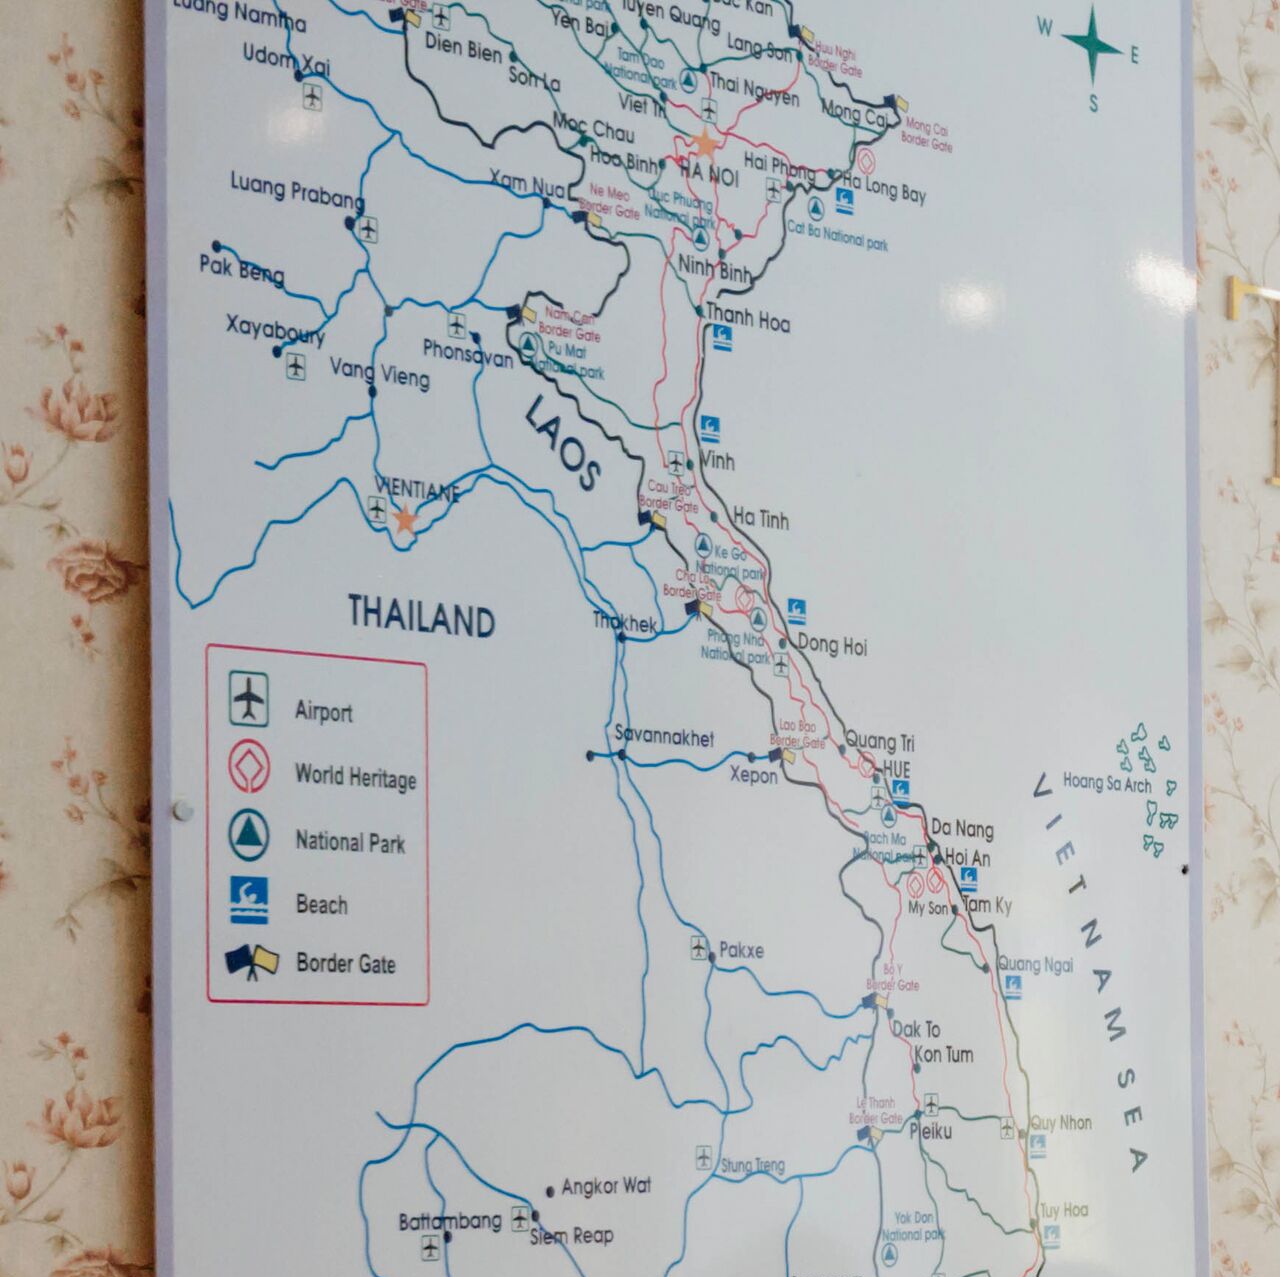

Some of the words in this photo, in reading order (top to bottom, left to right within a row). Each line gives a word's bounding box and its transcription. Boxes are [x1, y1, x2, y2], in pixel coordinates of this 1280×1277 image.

[552, 7, 580, 30] Yen
[669, 6, 720, 36] Quang
[1037, 15, 1053, 37] W
[243, 42, 293, 68] Udom
[302, 54, 330, 76] Xai
[425, 32, 461, 55] Dien
[467, 39, 502, 63] Bien
[727, 32, 763, 61] Lang
[1132, 45, 1139, 64] E
[618, 92, 648, 114] Viet
[711, 72, 741, 93] Thai
[744, 79, 800, 108] Nguyen
[822, 99, 861, 124] Mong
[1089, 94, 1098, 113] S
[553, 110, 587, 133] Moc
[593, 120, 635, 144] Chau
[591, 146, 620, 167] Hoa
[626, 153, 659, 175] Binh
[745, 152, 768, 172] Hai
[772, 158, 816, 182] Phong
[490, 168, 528, 192] Xam
[533, 175, 565, 198] Nua
[680, 160, 702, 180] HA
[709, 164, 739, 188] NOI
[231, 170, 285, 200] Luang
[291, 182, 364, 212] Prabang
[843, 172, 862, 189] Ha
[866, 178, 898, 201] Long
[902, 183, 927, 207] Bay
[823, 227, 865, 248] National
[200, 253, 233, 277] Pak
[240, 260, 285, 289] Beng
[679, 253, 714, 278] Ninh
[720, 261, 754, 284] Binh
[706, 301, 754, 327] Thanh
[760, 312, 790, 333] Hoa
[226, 313, 325, 350] Xayaboury
[423, 338, 514, 369] Phonsavan
[330, 356, 375, 384] Vang
[381, 363, 430, 393] Vieng
[526, 394, 601, 491] LAOS
[700, 450, 735, 471] Vinh
[374, 475, 460, 503] VIENTIANE
[733, 506, 756, 526] Ha
[760, 509, 790, 531] Tinh
[348, 594, 495, 638] THAILAND
[593, 610, 657, 633] Thakhek
[798, 632, 839, 659] Dong
[844, 637, 868, 657] Hoi
[295, 699, 353, 726] Airport
[615, 723, 715, 749] Savannakhet
[845, 729, 897, 755] Quang
[900, 734, 915, 752] Tri
[295, 762, 345, 786] World
[350, 766, 417, 795] Heritage
[730, 764, 778, 787] Xepon
[883, 760, 911, 779] HUE
[1063, 772, 1104, 794] Hoang
[1107, 775, 1122, 791] Sa
[1124, 776, 1153, 794] Arch
[296, 828, 364, 852] National
[369, 833, 406, 854] Park
[931, 817, 951, 836] Da
[955, 819, 994, 843] Nang
[945, 847, 969, 866] Hoi
[972, 849, 991, 867] An
[296, 893, 348, 915] Beach
[908, 901, 924, 917] My
[928, 901, 949, 915] Son
[963, 895, 992, 914] Tam
[995, 896, 1013, 917] Ky
[296, 952, 354, 973] Border
[359, 954, 396, 974] Gate
[720, 941, 764, 959] Pakxe
[999, 954, 1041, 975] Quang
[1044, 957, 1074, 974] Ngai
[892, 1020, 921, 1038] Dak
[926, 1021, 941, 1037] To
[915, 1046, 942, 1063] Kon
[946, 1047, 974, 1063] Tum
[1031, 1115, 1056, 1133] Quy
[1059, 1116, 1092, 1131] Nhon
[562, 1178, 619, 1199] Angkor
[622, 1176, 652, 1193] Wat
[399, 1211, 502, 1232] Battambang
[1040, 1202, 1061, 1221] Tuy
[1063, 1201, 1089, 1218] Hoa
[530, 1227, 569, 1246] Siem
[573, 1227, 615, 1245] Reap
